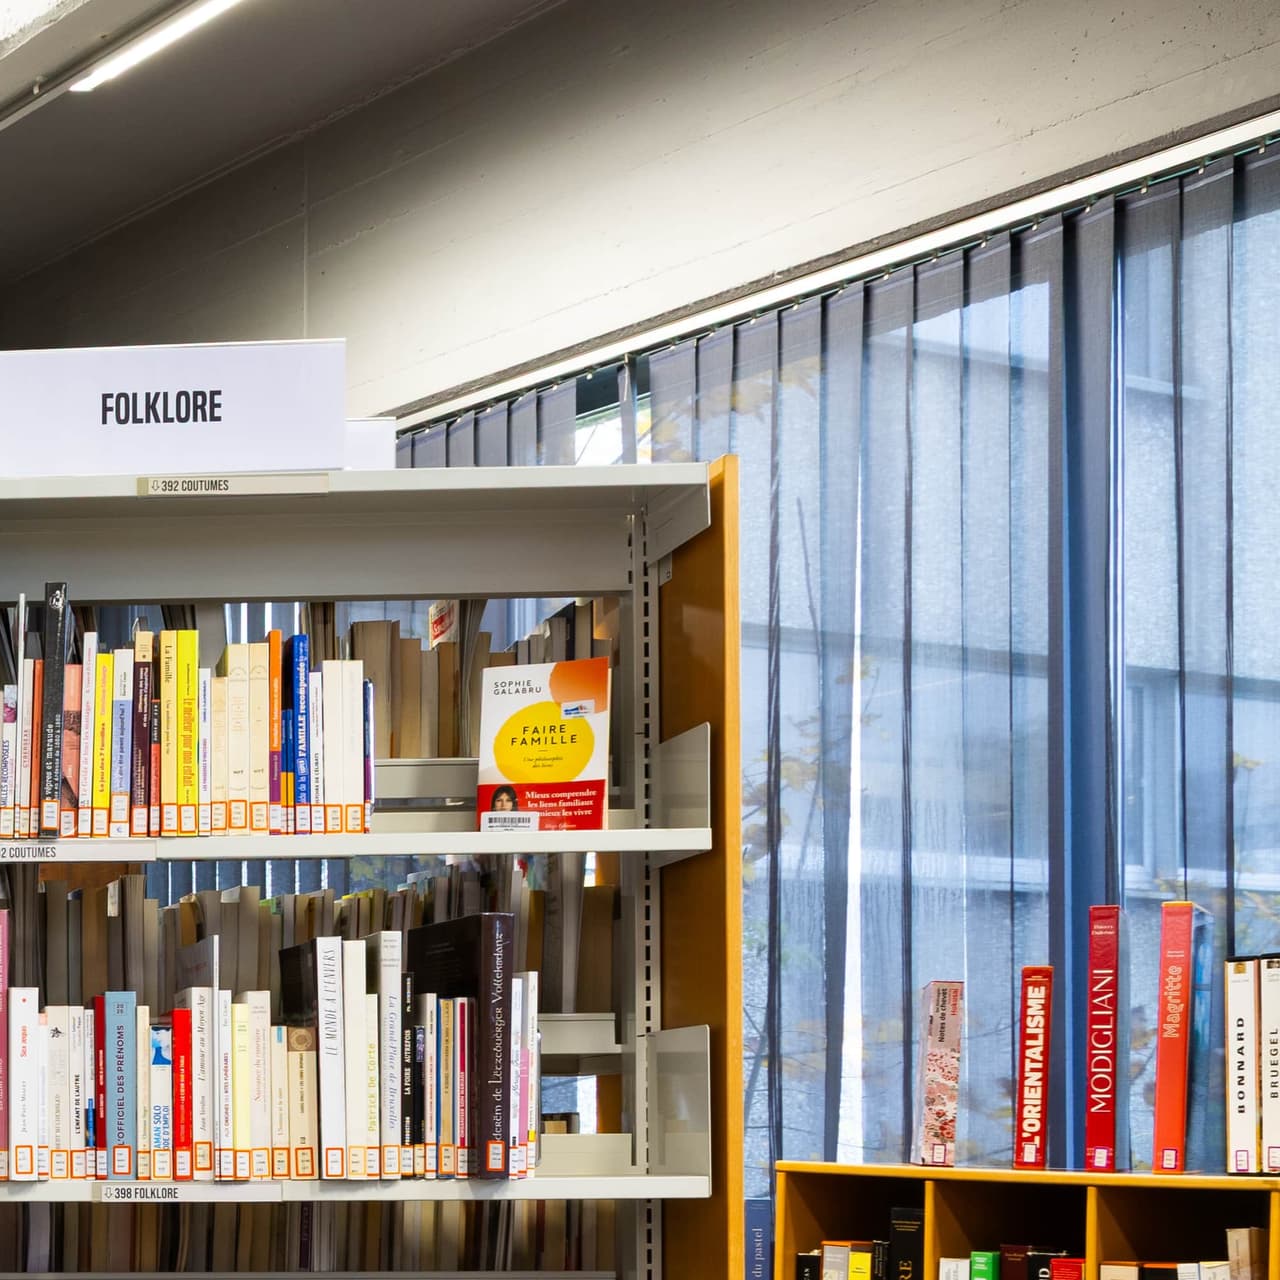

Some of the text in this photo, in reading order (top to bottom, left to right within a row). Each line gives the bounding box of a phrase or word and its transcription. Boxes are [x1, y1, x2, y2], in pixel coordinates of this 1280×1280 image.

[101, 390, 222, 425] FOLKLORE
[161, 480, 229, 492] 392 COUTUMES
[493, 679, 533, 689] SOPHIE
[493, 686, 542, 696] GALABRU
[522, 723, 567, 735] FAIRE
[511, 734, 578, 746] FAMILLE
[8, 847, 57, 859] COUTUMES
[1162, 965, 1184, 1039] Magritte
[1090, 968, 1115, 1114] MODIGLIANI
[1021, 985, 1046, 1149] L'ORIENTALISME
[1235, 1016, 1246, 1114] BONNARD
[1269, 1027, 1279, 1099] BRUEGEL
[114, 1187, 179, 1199] 398 FOLKLORE
